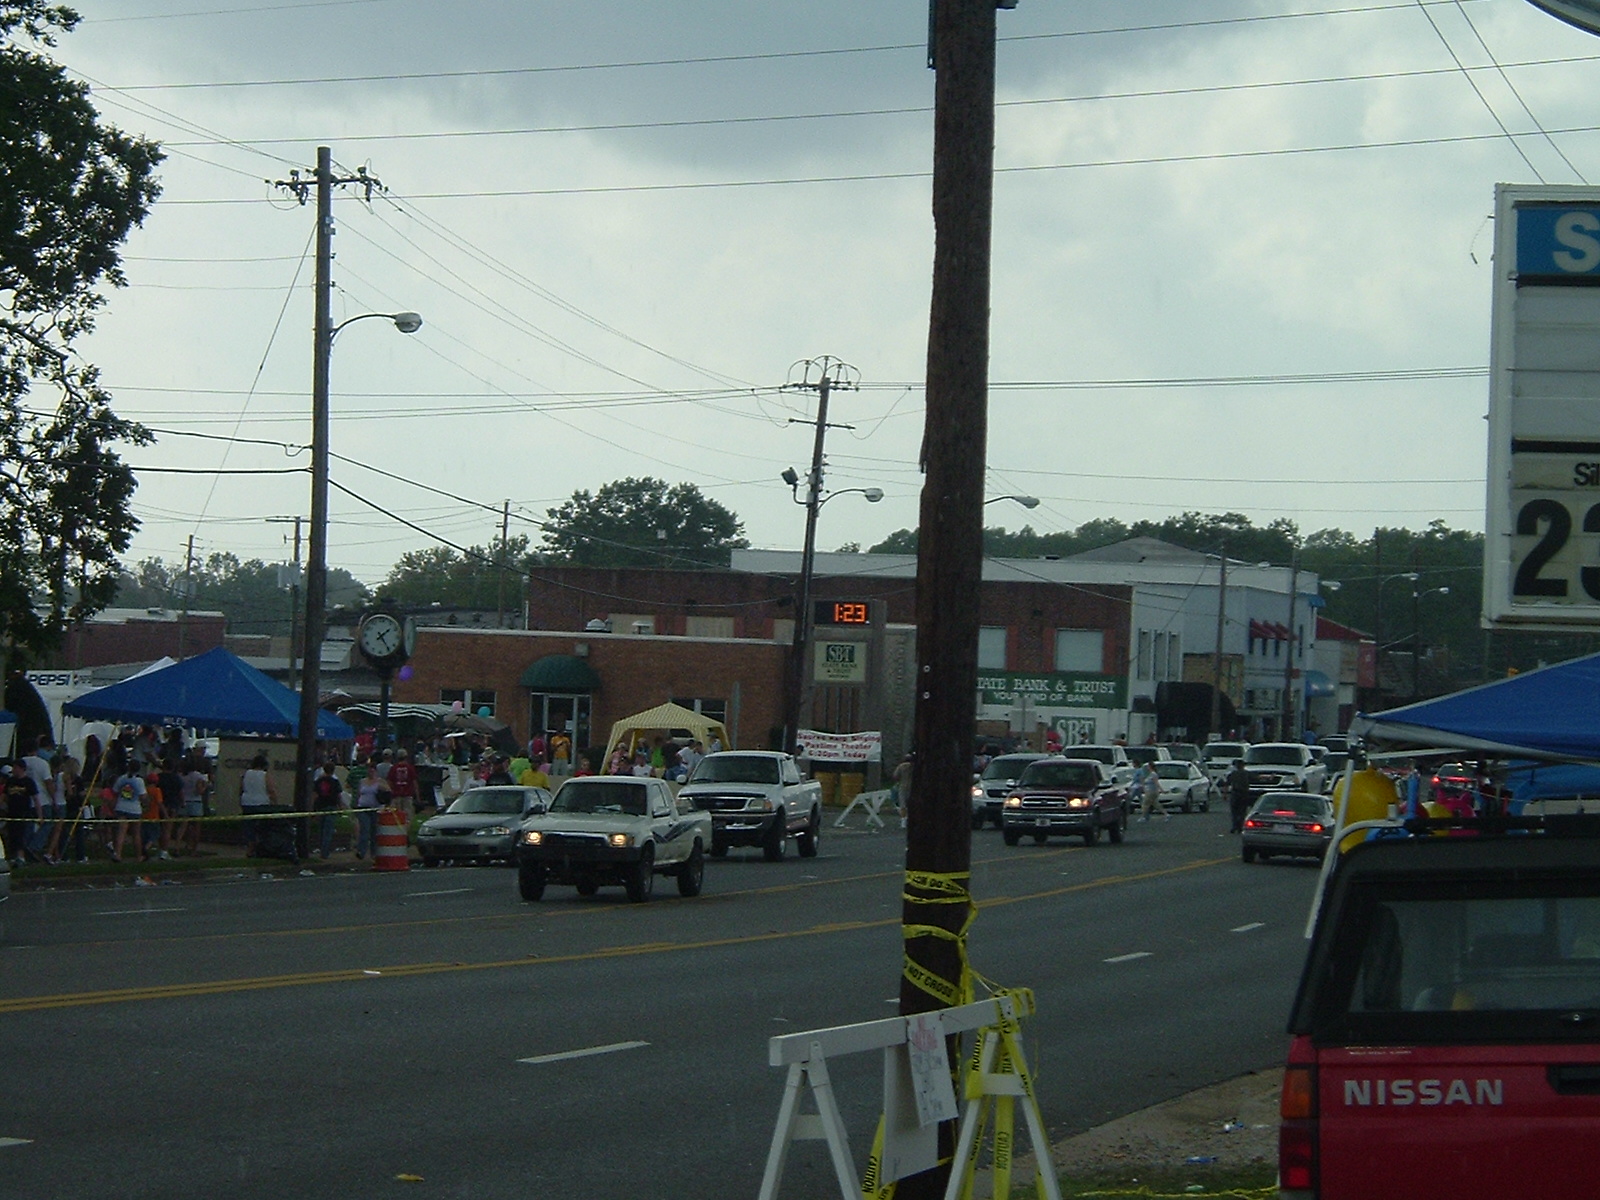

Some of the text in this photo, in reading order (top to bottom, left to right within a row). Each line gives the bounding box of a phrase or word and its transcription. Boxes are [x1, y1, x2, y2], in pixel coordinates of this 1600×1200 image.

[834, 603, 866, 623] 1:23
[828, 645, 852, 662] SBT
[29, 674, 70, 686] PEPSI
[976, 677, 1116, 693] TATE BANK & TRUST
[993, 691, 1095, 702] YOUR KIND OF BANK
[1056, 719, 1094, 746] SBT
[843, 751, 867, 759] Today
[908, 965, 954, 998] NOT CROSS
[1344, 1079, 1503, 1106] NISSAN
[861, 1155, 878, 1194] CAUTION
